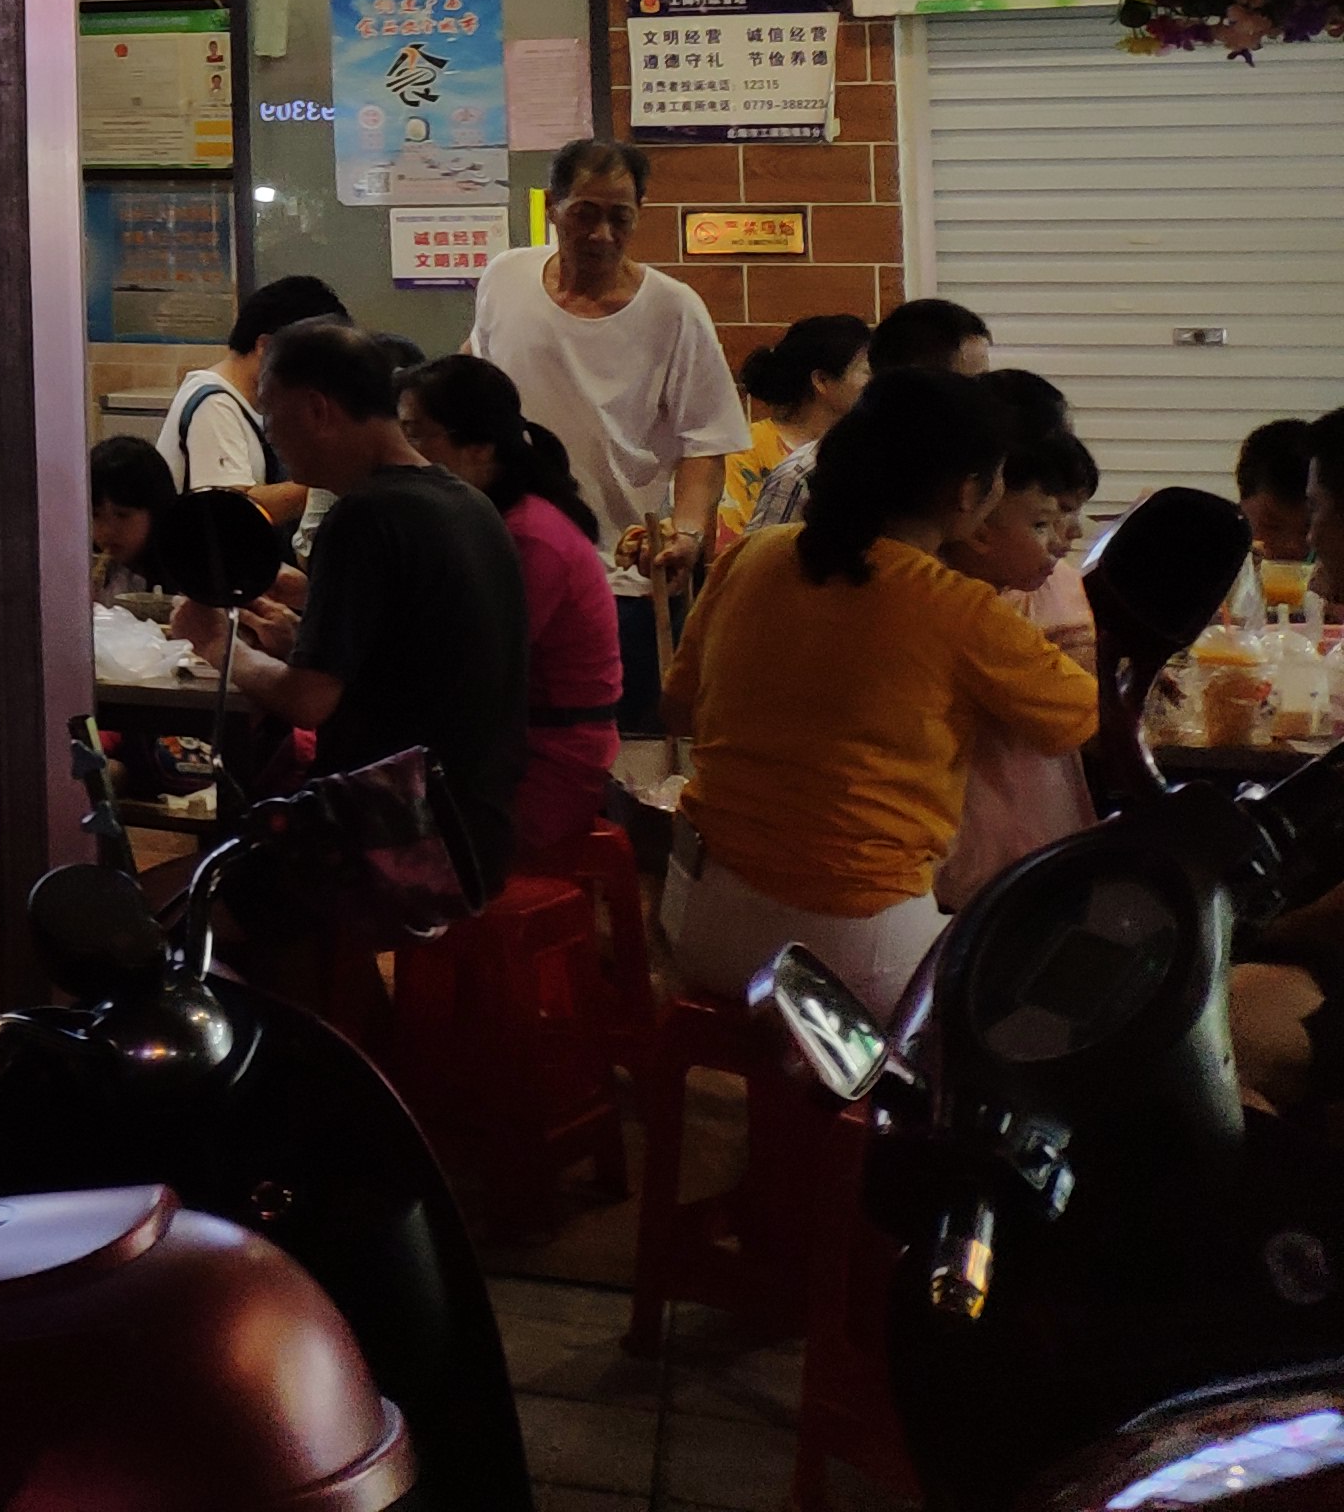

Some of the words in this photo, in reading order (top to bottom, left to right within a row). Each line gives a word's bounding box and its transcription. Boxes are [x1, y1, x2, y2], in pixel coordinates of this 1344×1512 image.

[642, 28, 722, 46] 文明经营
[746, 26, 828, 43] 诚信经营
[748, 50, 828, 67] 节俭养德
[743, 79, 780, 90] 12315
[414, 230, 489, 246] 诚信经营
[415, 252, 489, 268] 文明消费
